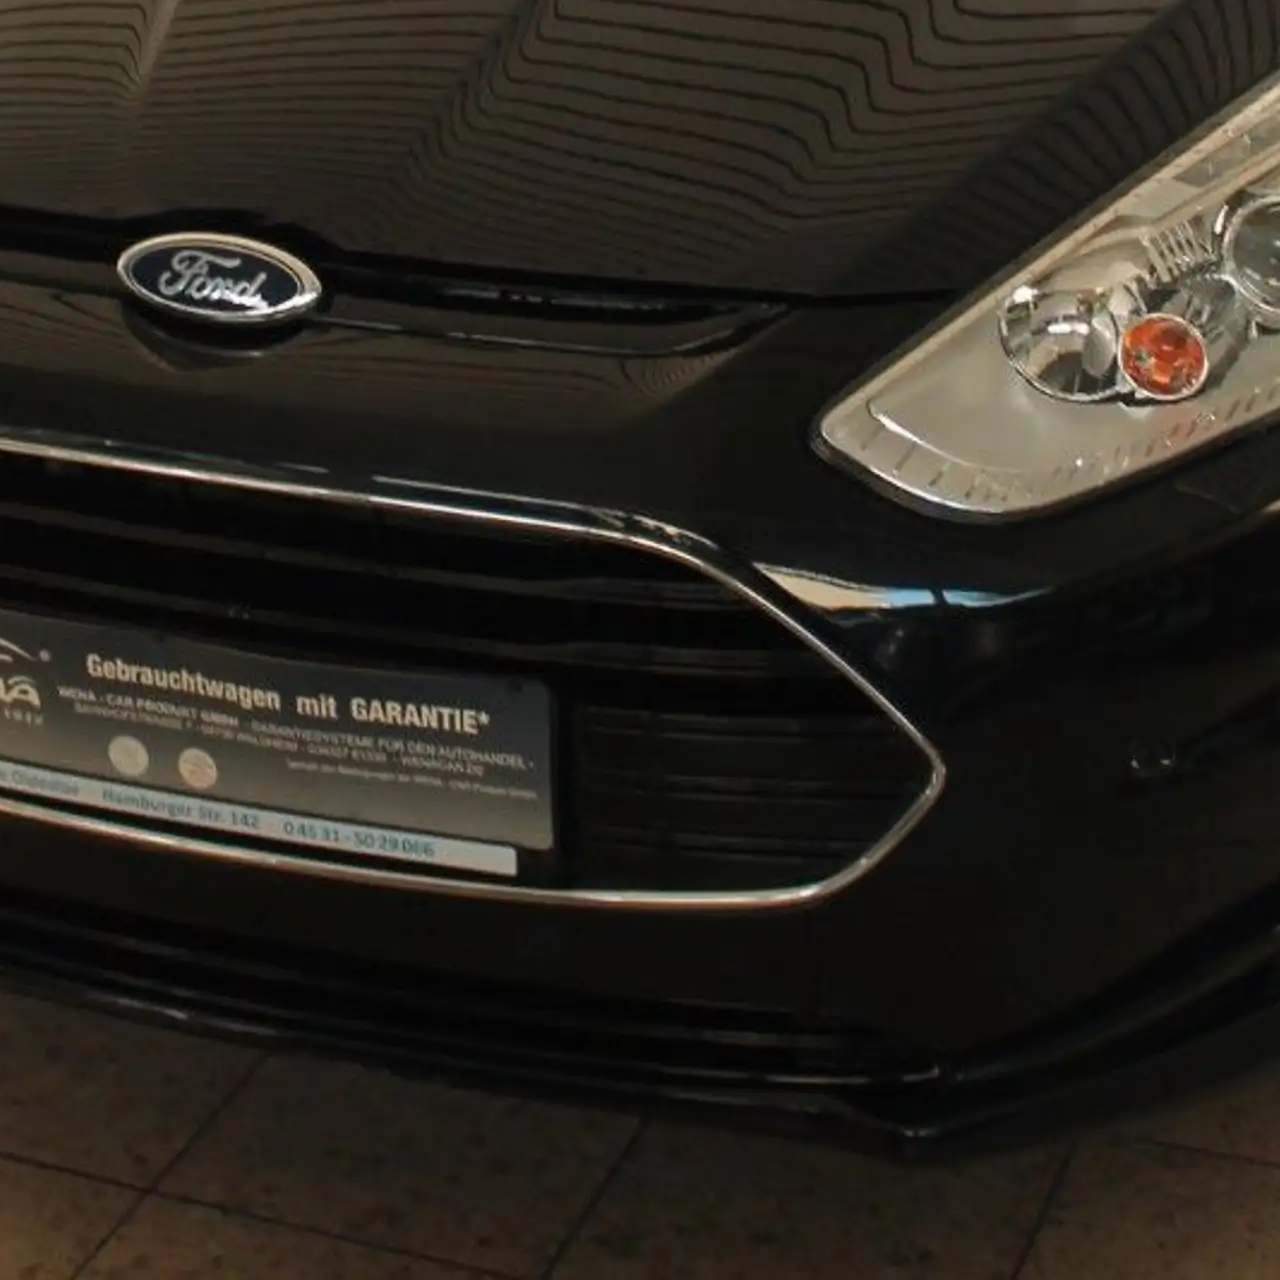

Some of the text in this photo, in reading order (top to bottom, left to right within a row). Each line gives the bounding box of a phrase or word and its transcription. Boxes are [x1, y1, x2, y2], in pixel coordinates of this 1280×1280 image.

[157, 249, 268, 307] Ford
[86, 653, 281, 712] Gebrauchtwagen
[296, 694, 338, 719] mit
